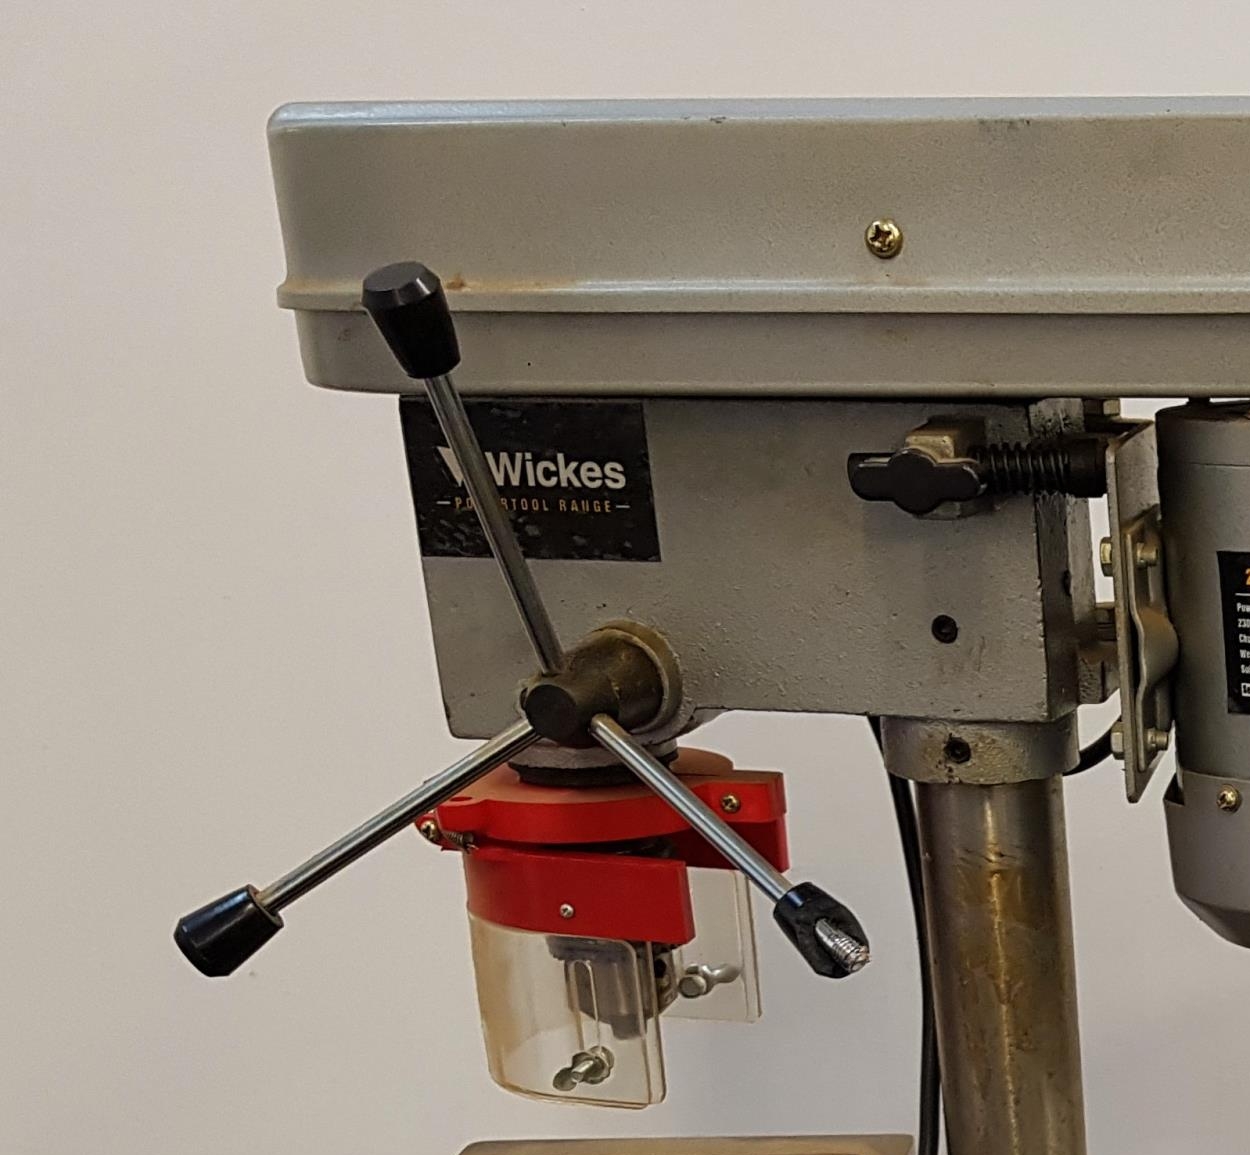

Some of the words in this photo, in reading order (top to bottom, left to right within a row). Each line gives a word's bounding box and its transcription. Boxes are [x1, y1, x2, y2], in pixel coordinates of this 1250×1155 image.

[485, 452, 626, 489] Wickes
[454, 497, 549, 512] PORTOOL
[559, 499, 611, 513] RANGE
